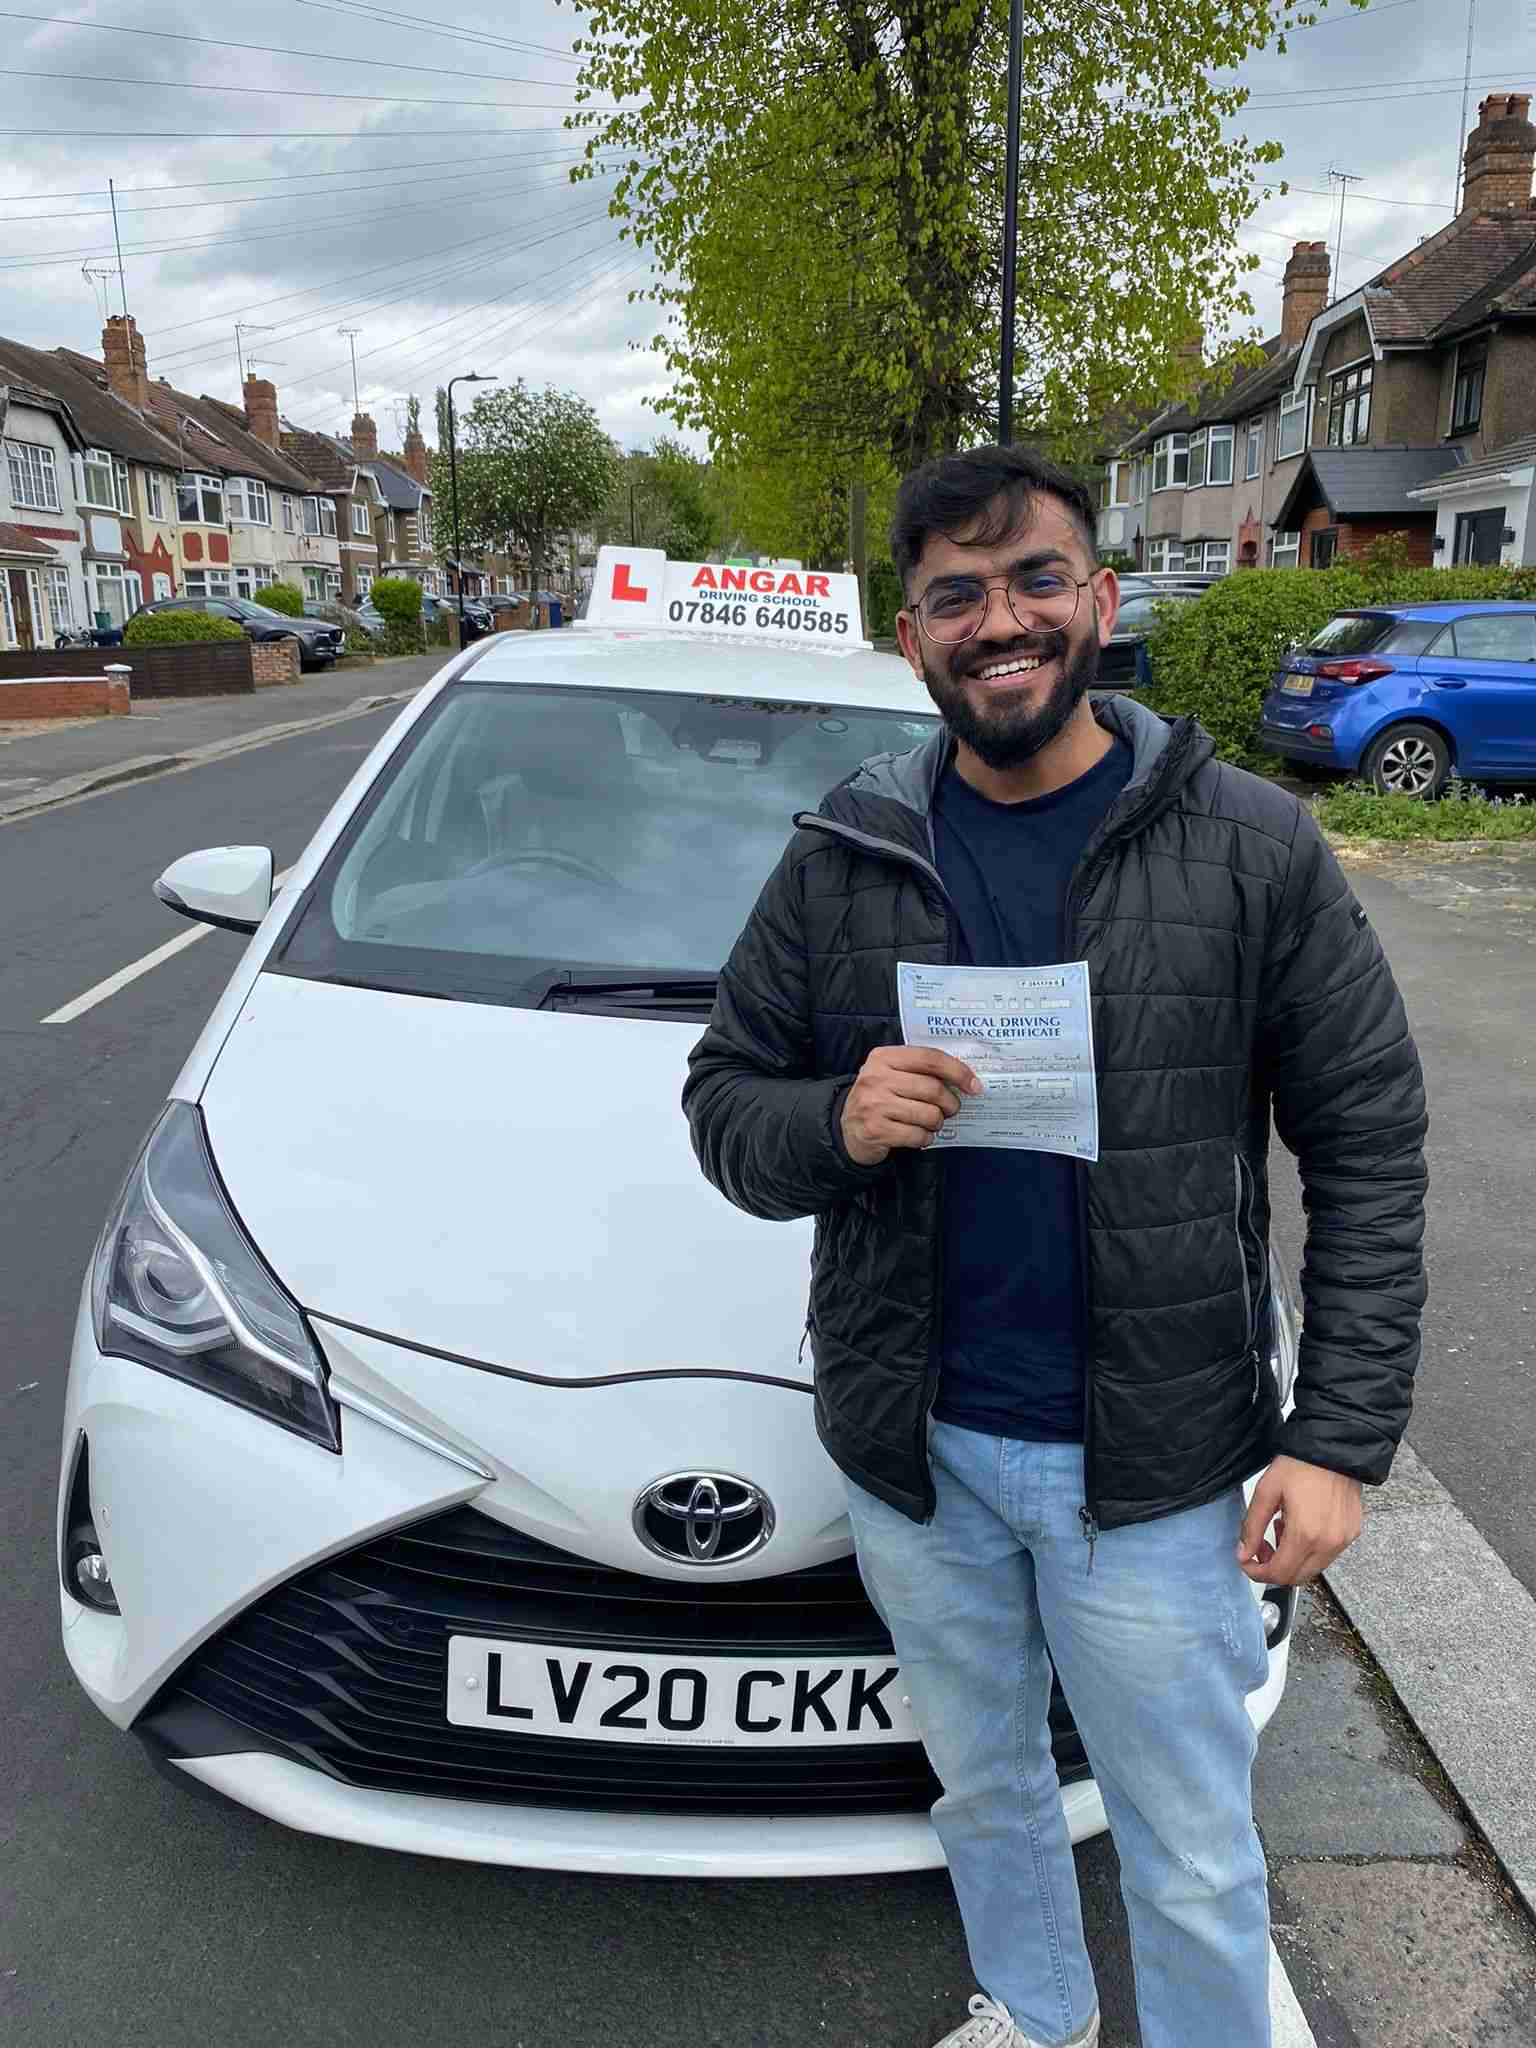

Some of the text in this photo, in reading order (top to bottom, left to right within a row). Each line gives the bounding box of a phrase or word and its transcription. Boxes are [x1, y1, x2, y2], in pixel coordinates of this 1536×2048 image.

[611, 563, 649, 603] L
[691, 566, 832, 598] ANGAR
[699, 589, 821, 608] DRIVING SCHOOL
[668, 600, 849, 635] 07846 640585
[927, 1015, 1061, 1028] PRACTICAL DRIVING
[929, 1026, 1062, 1038] TEST PASS CERTIFICATE
[486, 1651, 899, 1733] LV20 CKK
